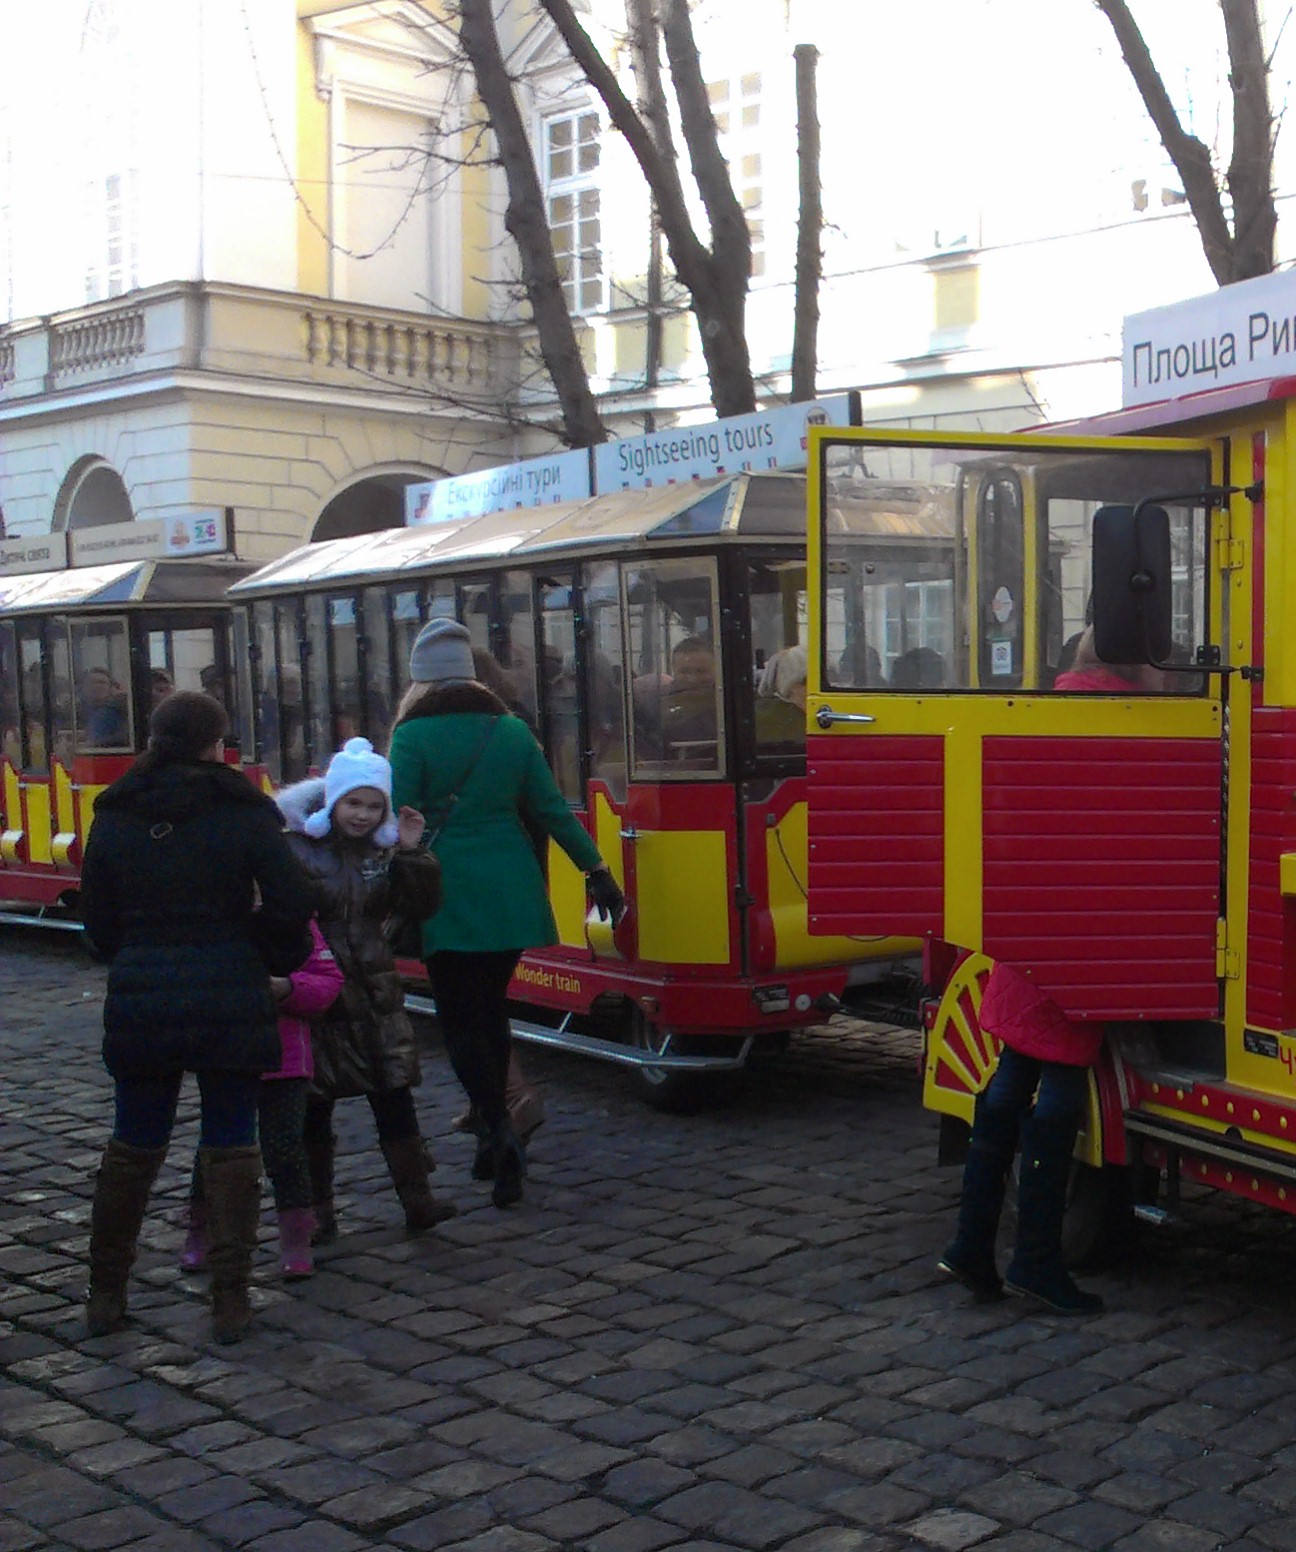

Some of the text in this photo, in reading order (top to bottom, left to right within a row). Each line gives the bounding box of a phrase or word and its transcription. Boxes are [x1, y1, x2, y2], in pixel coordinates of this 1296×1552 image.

[1133, 332, 1236, 388] Площа
[619, 422, 773, 476] Sightseeing tours
[526, 465, 561, 495] тури
[514, 962, 581, 994] Wonder train
